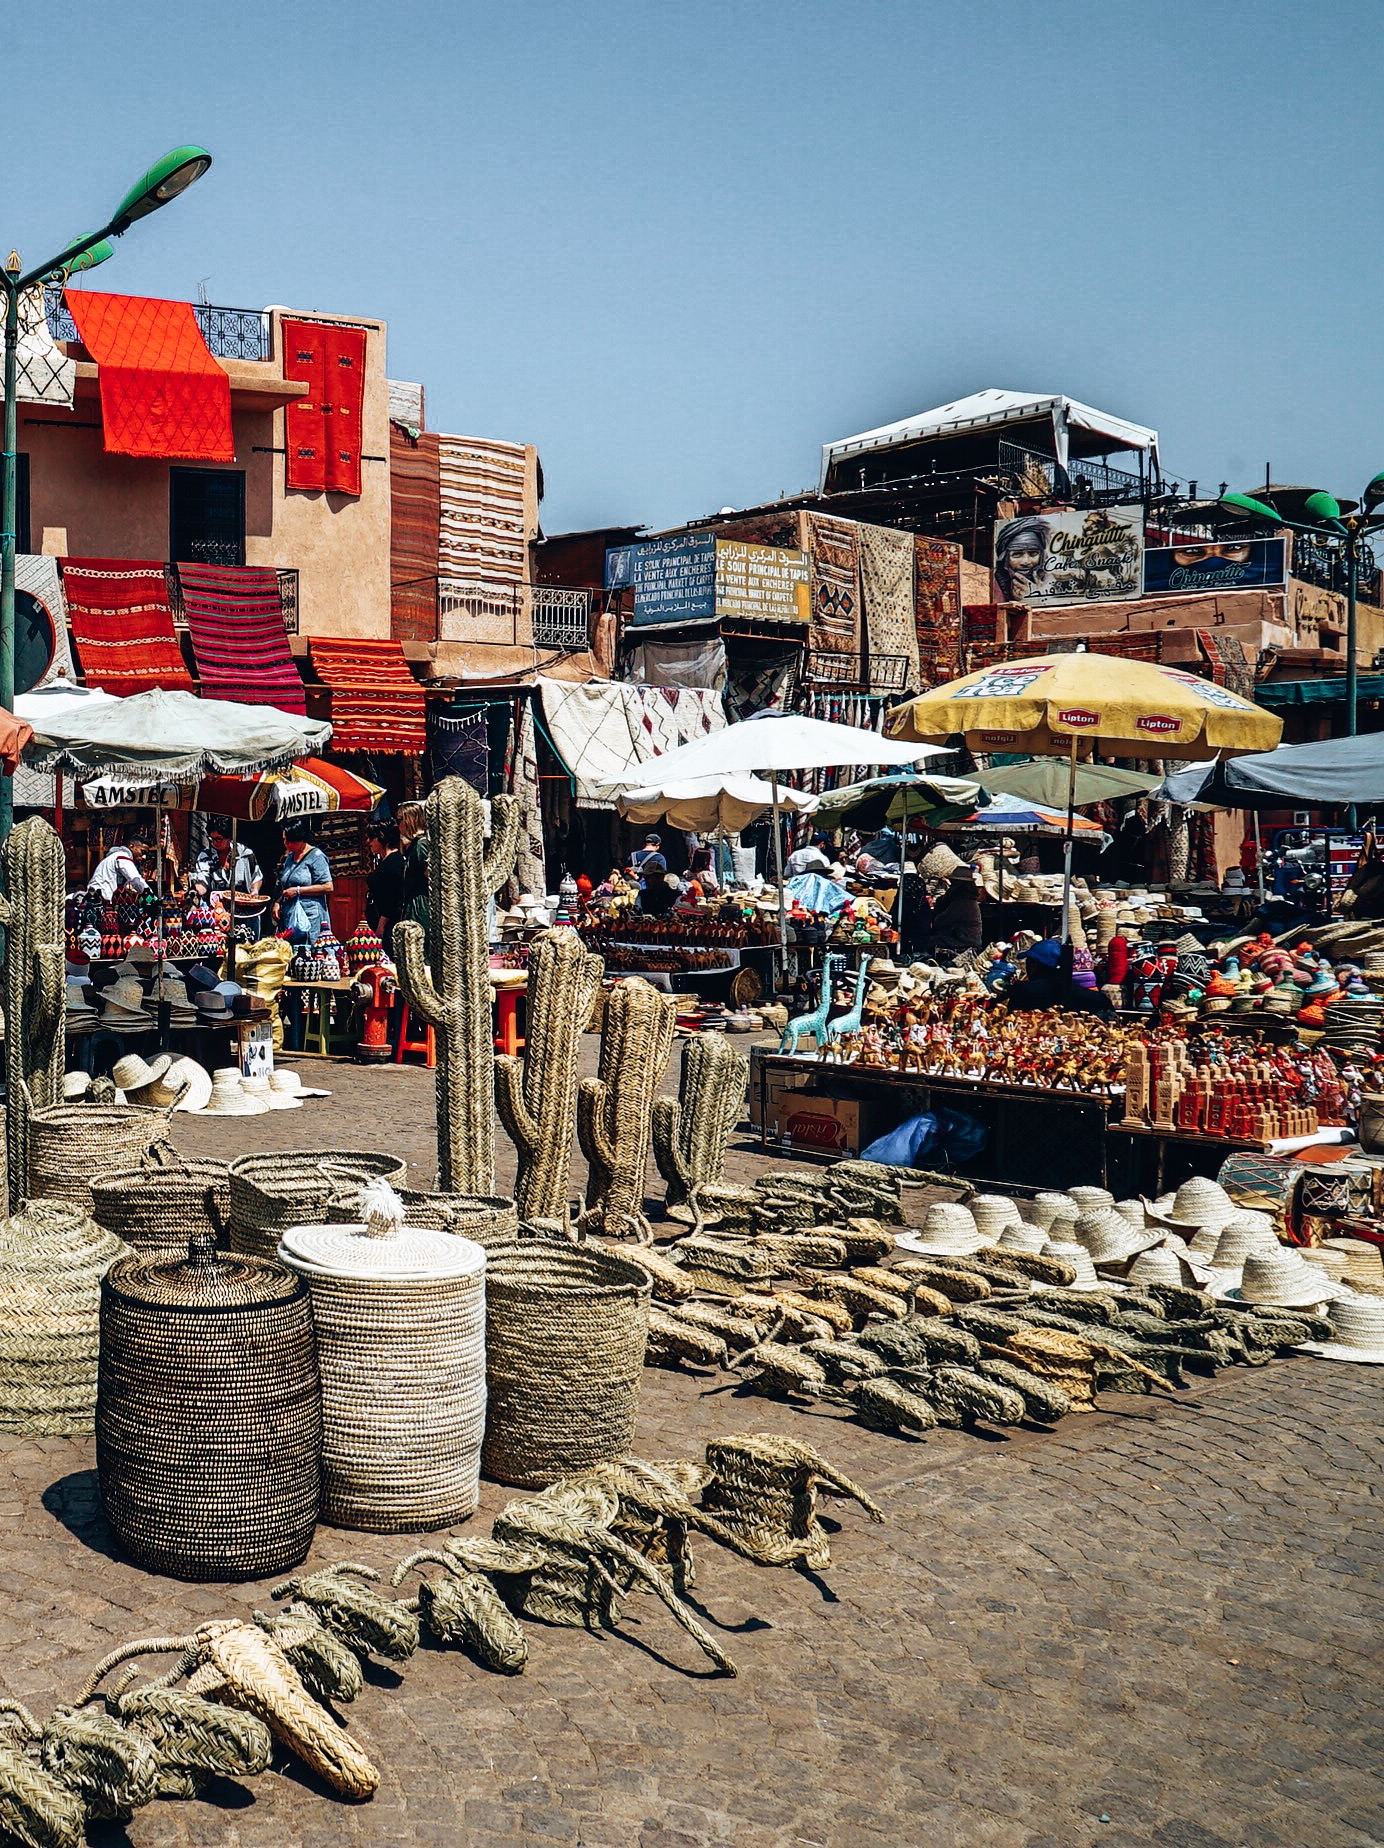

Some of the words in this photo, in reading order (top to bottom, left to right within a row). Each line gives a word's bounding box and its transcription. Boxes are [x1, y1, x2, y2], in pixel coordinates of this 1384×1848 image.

[1049, 524, 1133, 555] Chinguitti
[634, 562, 643, 572] LE
[645, 559, 661, 570] SOUK
[662, 555, 693, 568] PRINCIPAL
[694, 553, 700, 564] DE
[701, 552, 716, 562] TAPIS
[1086, 551, 1134, 567] Snack
[634, 572, 642, 582] LA
[644, 568, 664, 581] VENTE
[665, 567, 677, 578] AUX
[679, 563, 712, 576] ENCHERES
[716, 559, 725, 570] LE
[727, 560, 747, 573] SOUK
[748, 563, 782, 578] PRINCIPAL
[782, 567, 790, 578] DE
[790, 568, 809, 581] TAPIS
[644, 580, 668, 592] PRINCIPAL
[668, 577, 688, 589] MARKET
[689, 576, 696, 586] OF
[716, 572, 725, 582] LA
[726, 574, 747, 585] VENTE
[748, 577, 760, 587] AUX
[762, 578, 795, 591] ENCHERES
[996, 667, 1046, 675] Lipton
[1062, 713, 1095, 724] Lipton
[1140, 720, 1176, 730] Lipton
[95, 786, 169, 804] AMSTEL
[279, 791, 322, 818] AMSTEL
